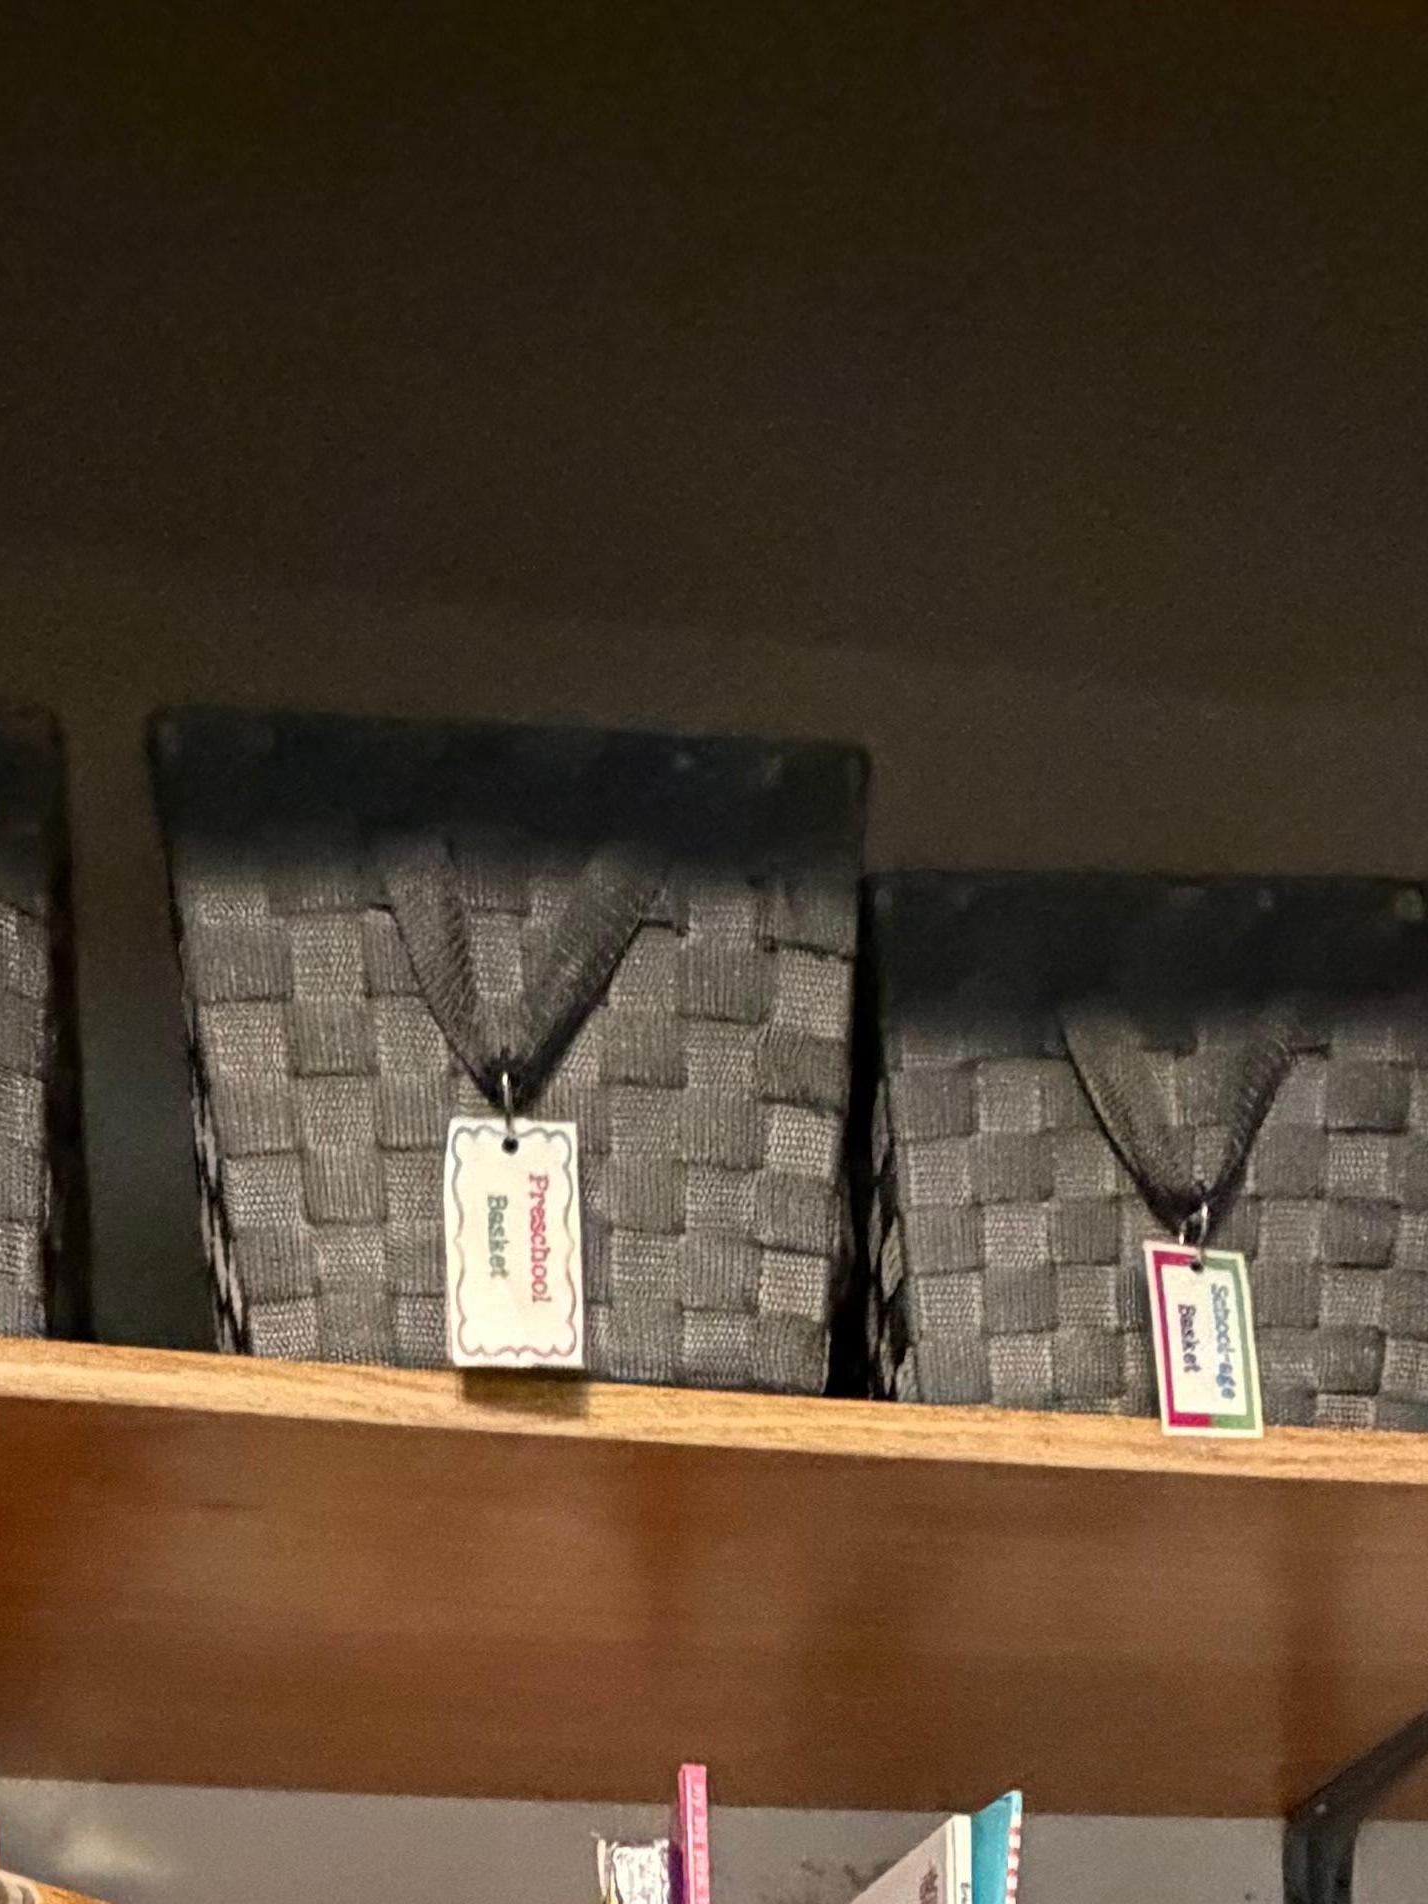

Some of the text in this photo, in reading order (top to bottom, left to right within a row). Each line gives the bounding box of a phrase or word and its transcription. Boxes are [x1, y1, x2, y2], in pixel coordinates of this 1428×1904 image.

[487, 1194, 510, 1280] Basket
[528, 1172, 552, 1304] Preschool
[1177, 1303, 1202, 1374] Basket
